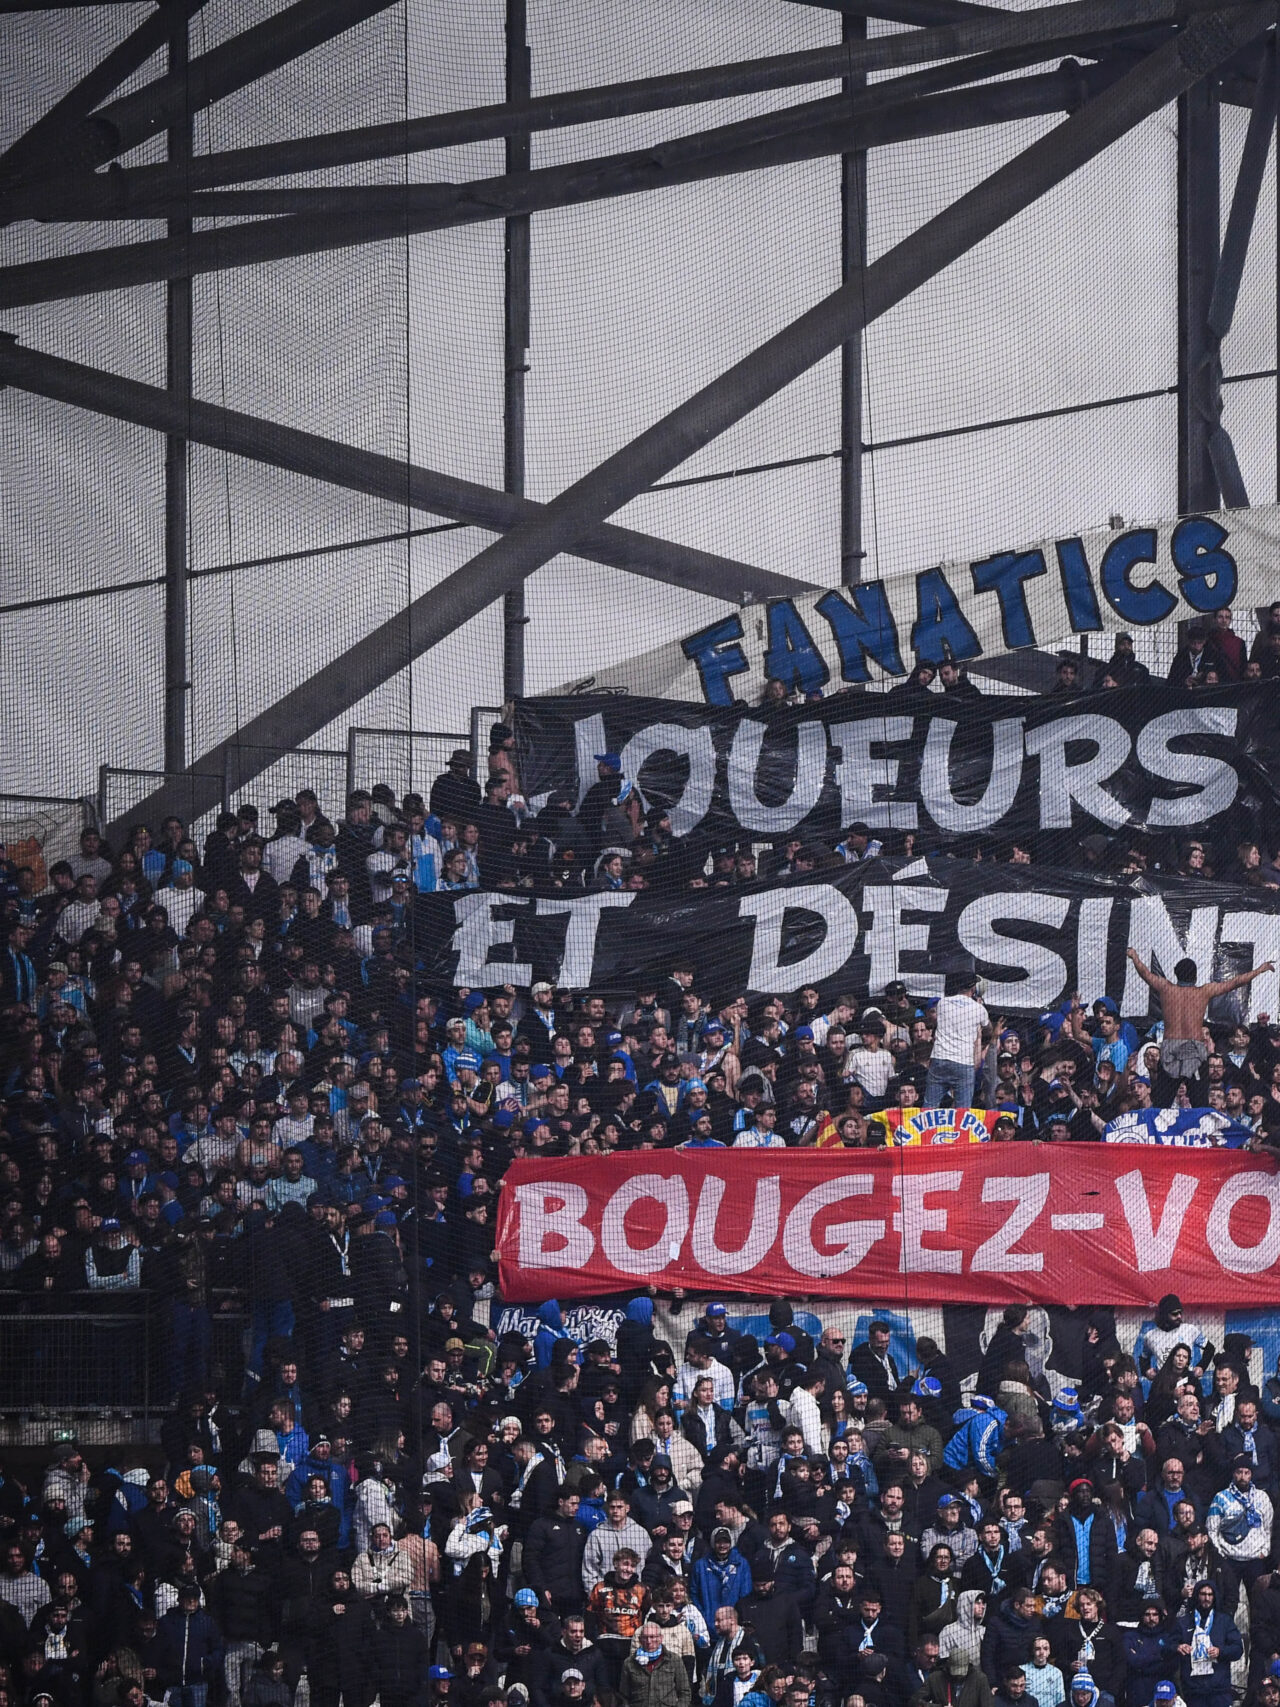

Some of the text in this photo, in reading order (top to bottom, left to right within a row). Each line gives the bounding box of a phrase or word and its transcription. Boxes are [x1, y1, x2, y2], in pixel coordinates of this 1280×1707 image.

[680, 516, 1237, 706] FANATICS
[528, 707, 1238, 838] JOUEURS
[452, 891, 638, 988] ET
